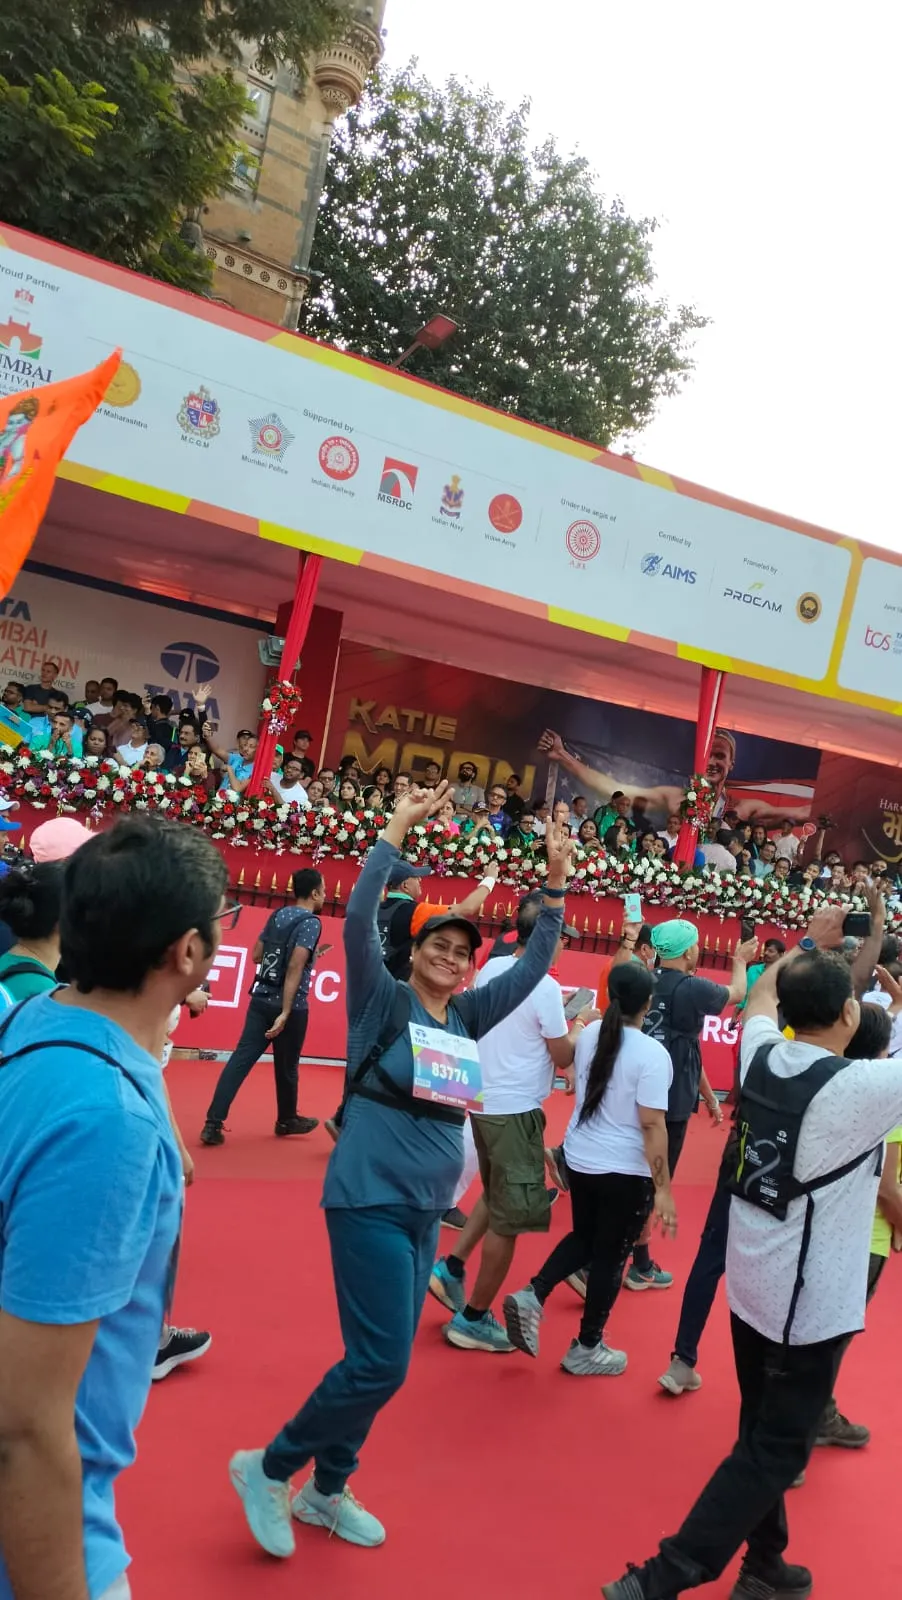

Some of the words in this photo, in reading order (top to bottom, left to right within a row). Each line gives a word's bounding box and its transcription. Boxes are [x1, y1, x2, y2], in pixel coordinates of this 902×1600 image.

[0, 264, 23, 280] roud
[25, 274, 60, 292] Partner
[0, 354, 52, 382] MBAI
[104, 409, 148, 429] Maharashtra
[303, 408, 343, 430] Supported
[344, 423, 354, 434] by
[241, 454, 268, 469] Mumbai
[268, 463, 289, 475] Police
[311, 478, 331, 489] Indian
[332, 484, 355, 498] Railway
[377, 493, 413, 511] MSRDC
[560, 497, 580, 510] Under
[581, 504, 591, 514] the
[609, 514, 617, 522] of
[449, 521, 464, 532] Navy
[684, 538, 692, 548] by
[661, 564, 698, 584] AIMS
[769, 565, 778, 575] by
[723, 587, 783, 613] PROCAM
[864, 624, 892, 651] tcs
[144, 683, 220, 721] TATA
[348, 697, 458, 742] KATIE
[342, 731, 537, 800] MOON
[880, 798, 902, 811] HAR
[431, 1061, 470, 1086] 83776
